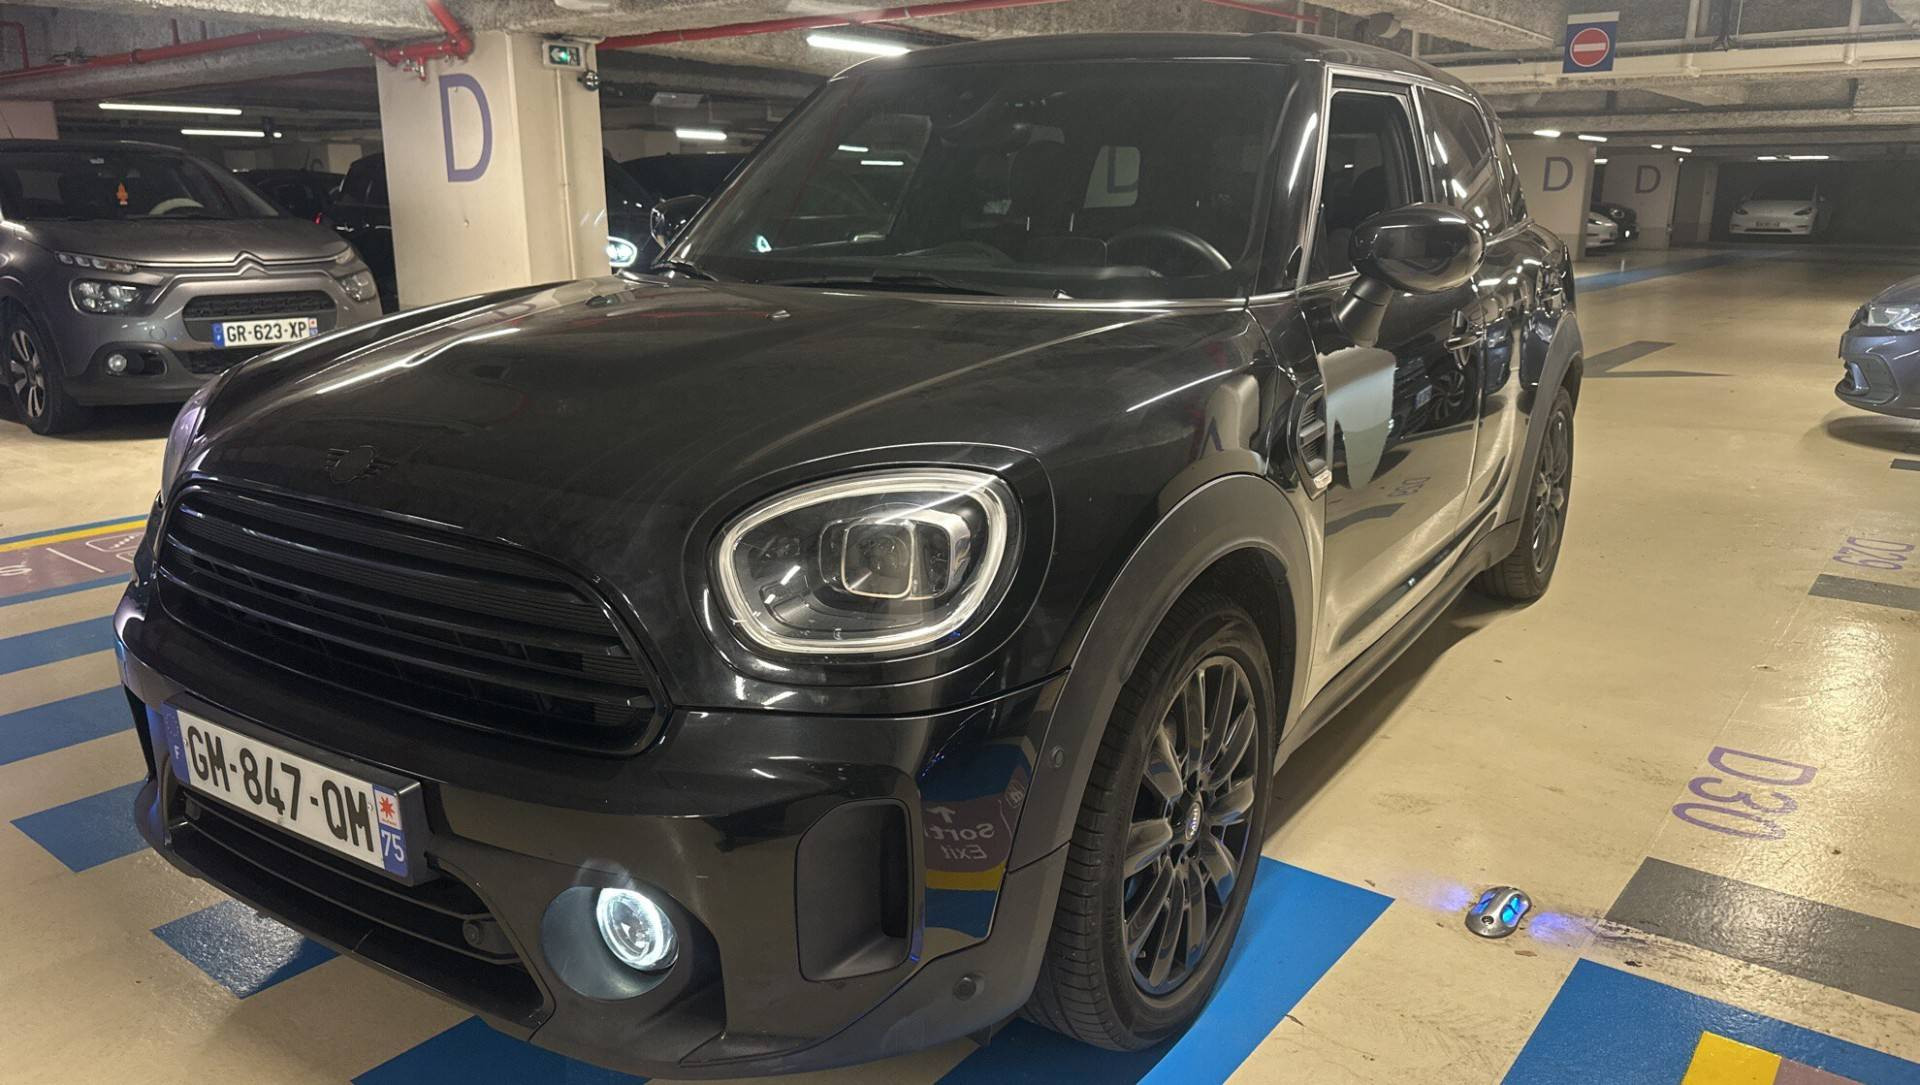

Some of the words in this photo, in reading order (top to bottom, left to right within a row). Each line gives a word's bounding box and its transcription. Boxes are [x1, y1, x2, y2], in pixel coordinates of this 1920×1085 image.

[439, 73, 493, 182] D
[1543, 156, 1573, 191] D
[1635, 165, 1661, 193] D
[226, 321, 307, 342] GR-623-XP
[1832, 536, 1915, 570] D29
[187, 725, 374, 852] GM-847-QM
[1672, 746, 1818, 840] D30
[381, 829, 405, 862] 75
